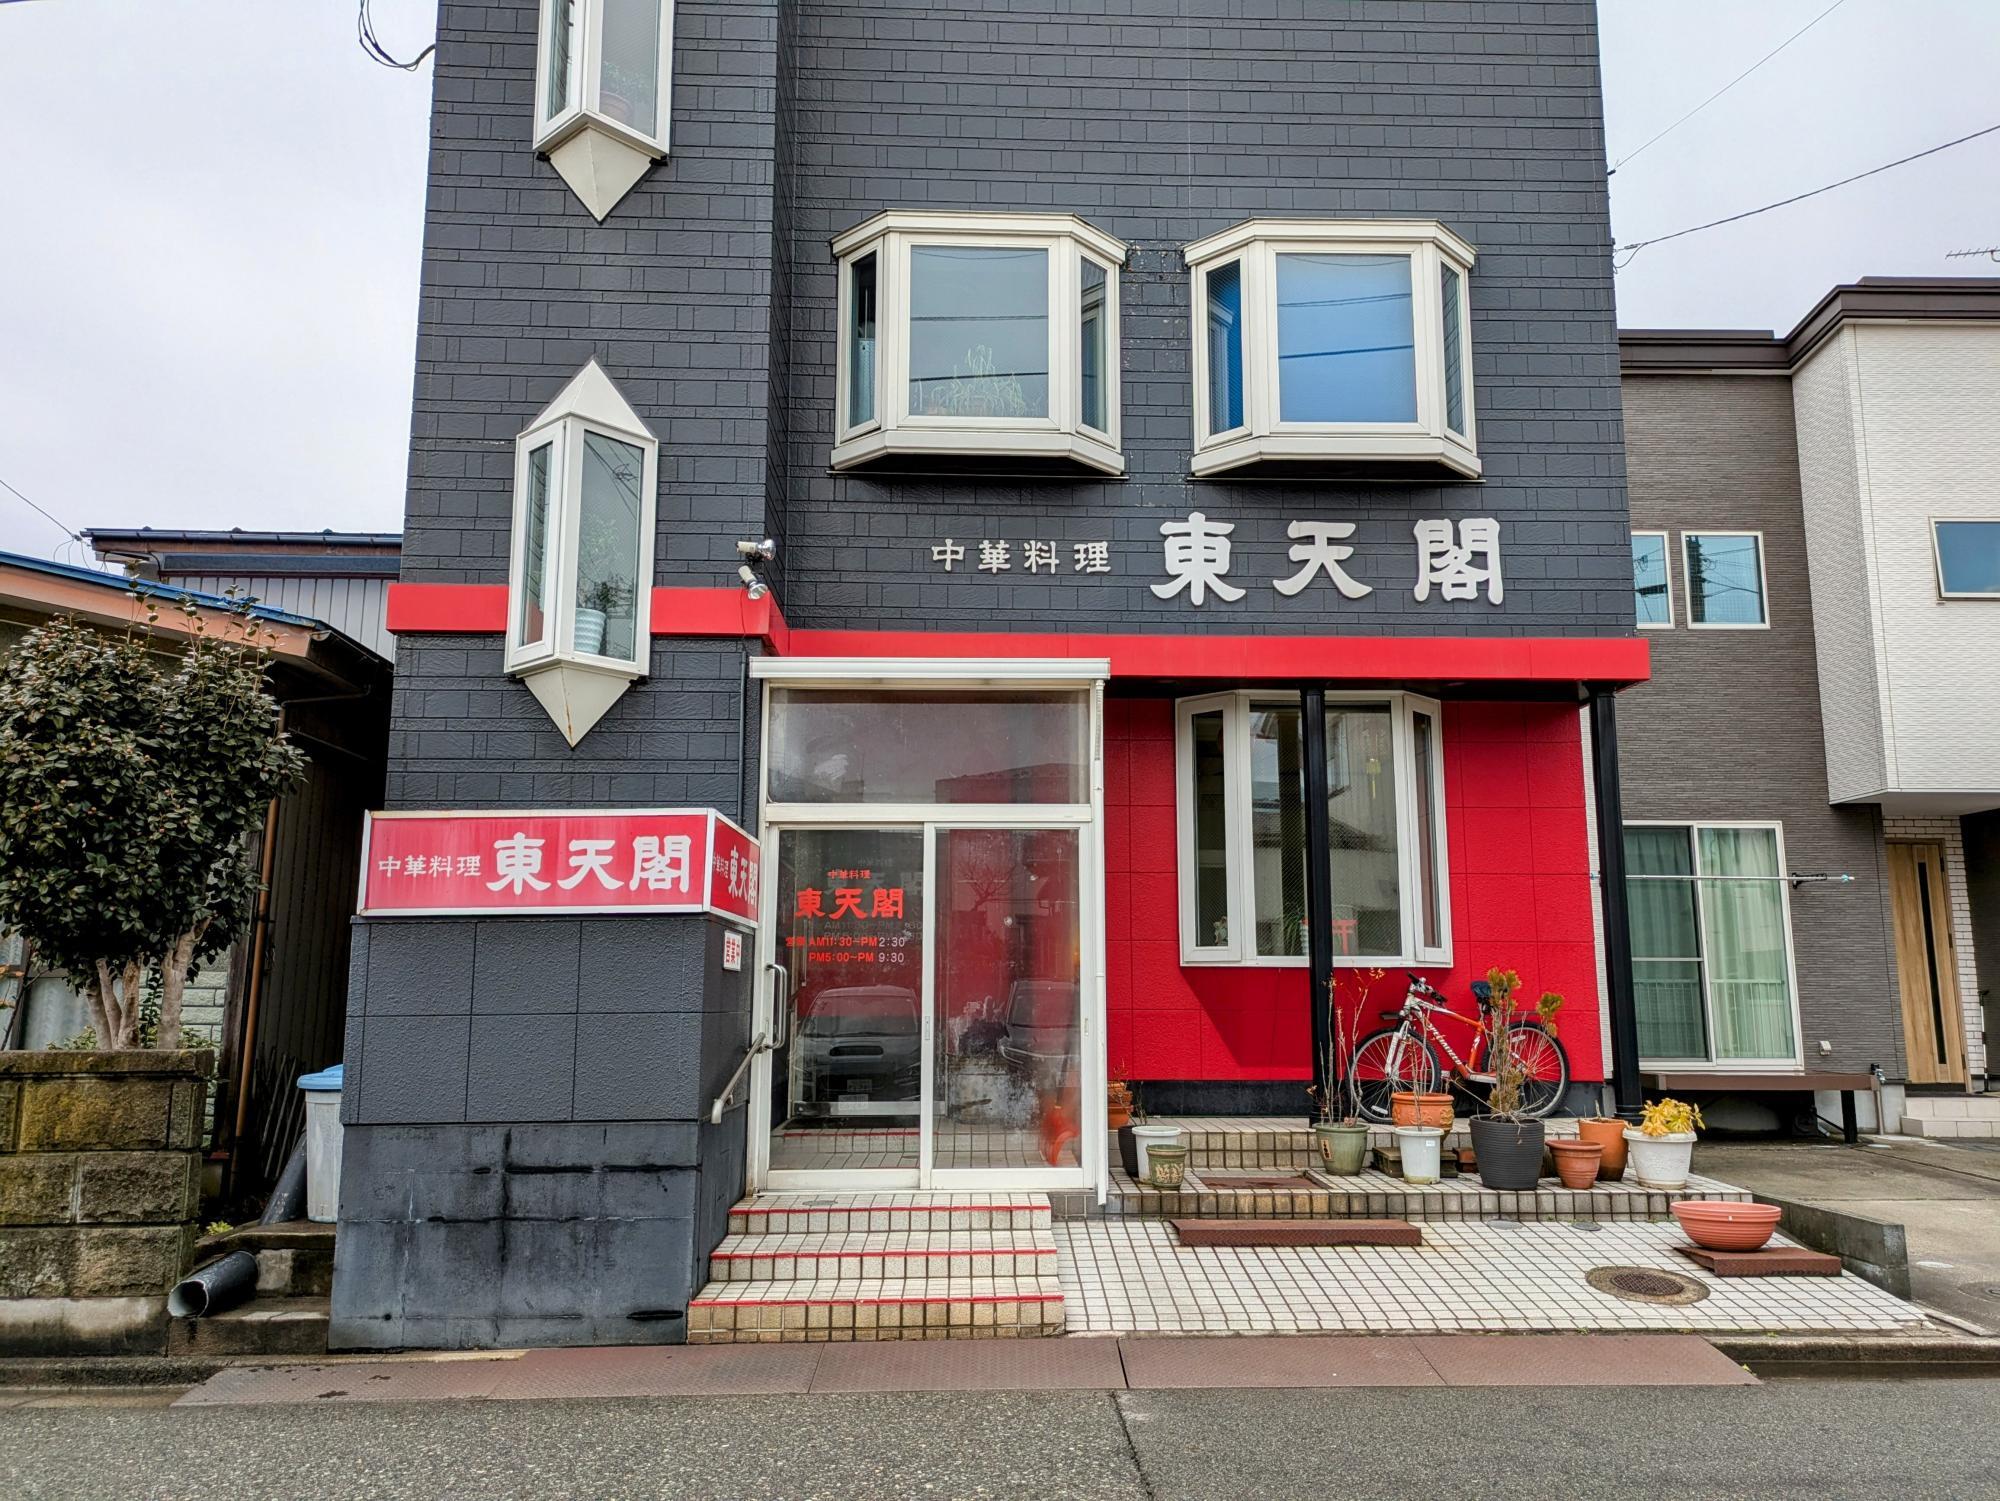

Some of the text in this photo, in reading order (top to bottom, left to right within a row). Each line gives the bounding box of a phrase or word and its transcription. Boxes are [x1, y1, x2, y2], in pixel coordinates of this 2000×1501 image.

[931, 510, 1505, 606] 中華料理 東天閣
[377, 831, 692, 896] 中華料理 東天閣
[728, 844, 758, 909] 東天閣
[827, 869, 872, 880] 中華料理
[795, 887, 904, 919] 東天閣
